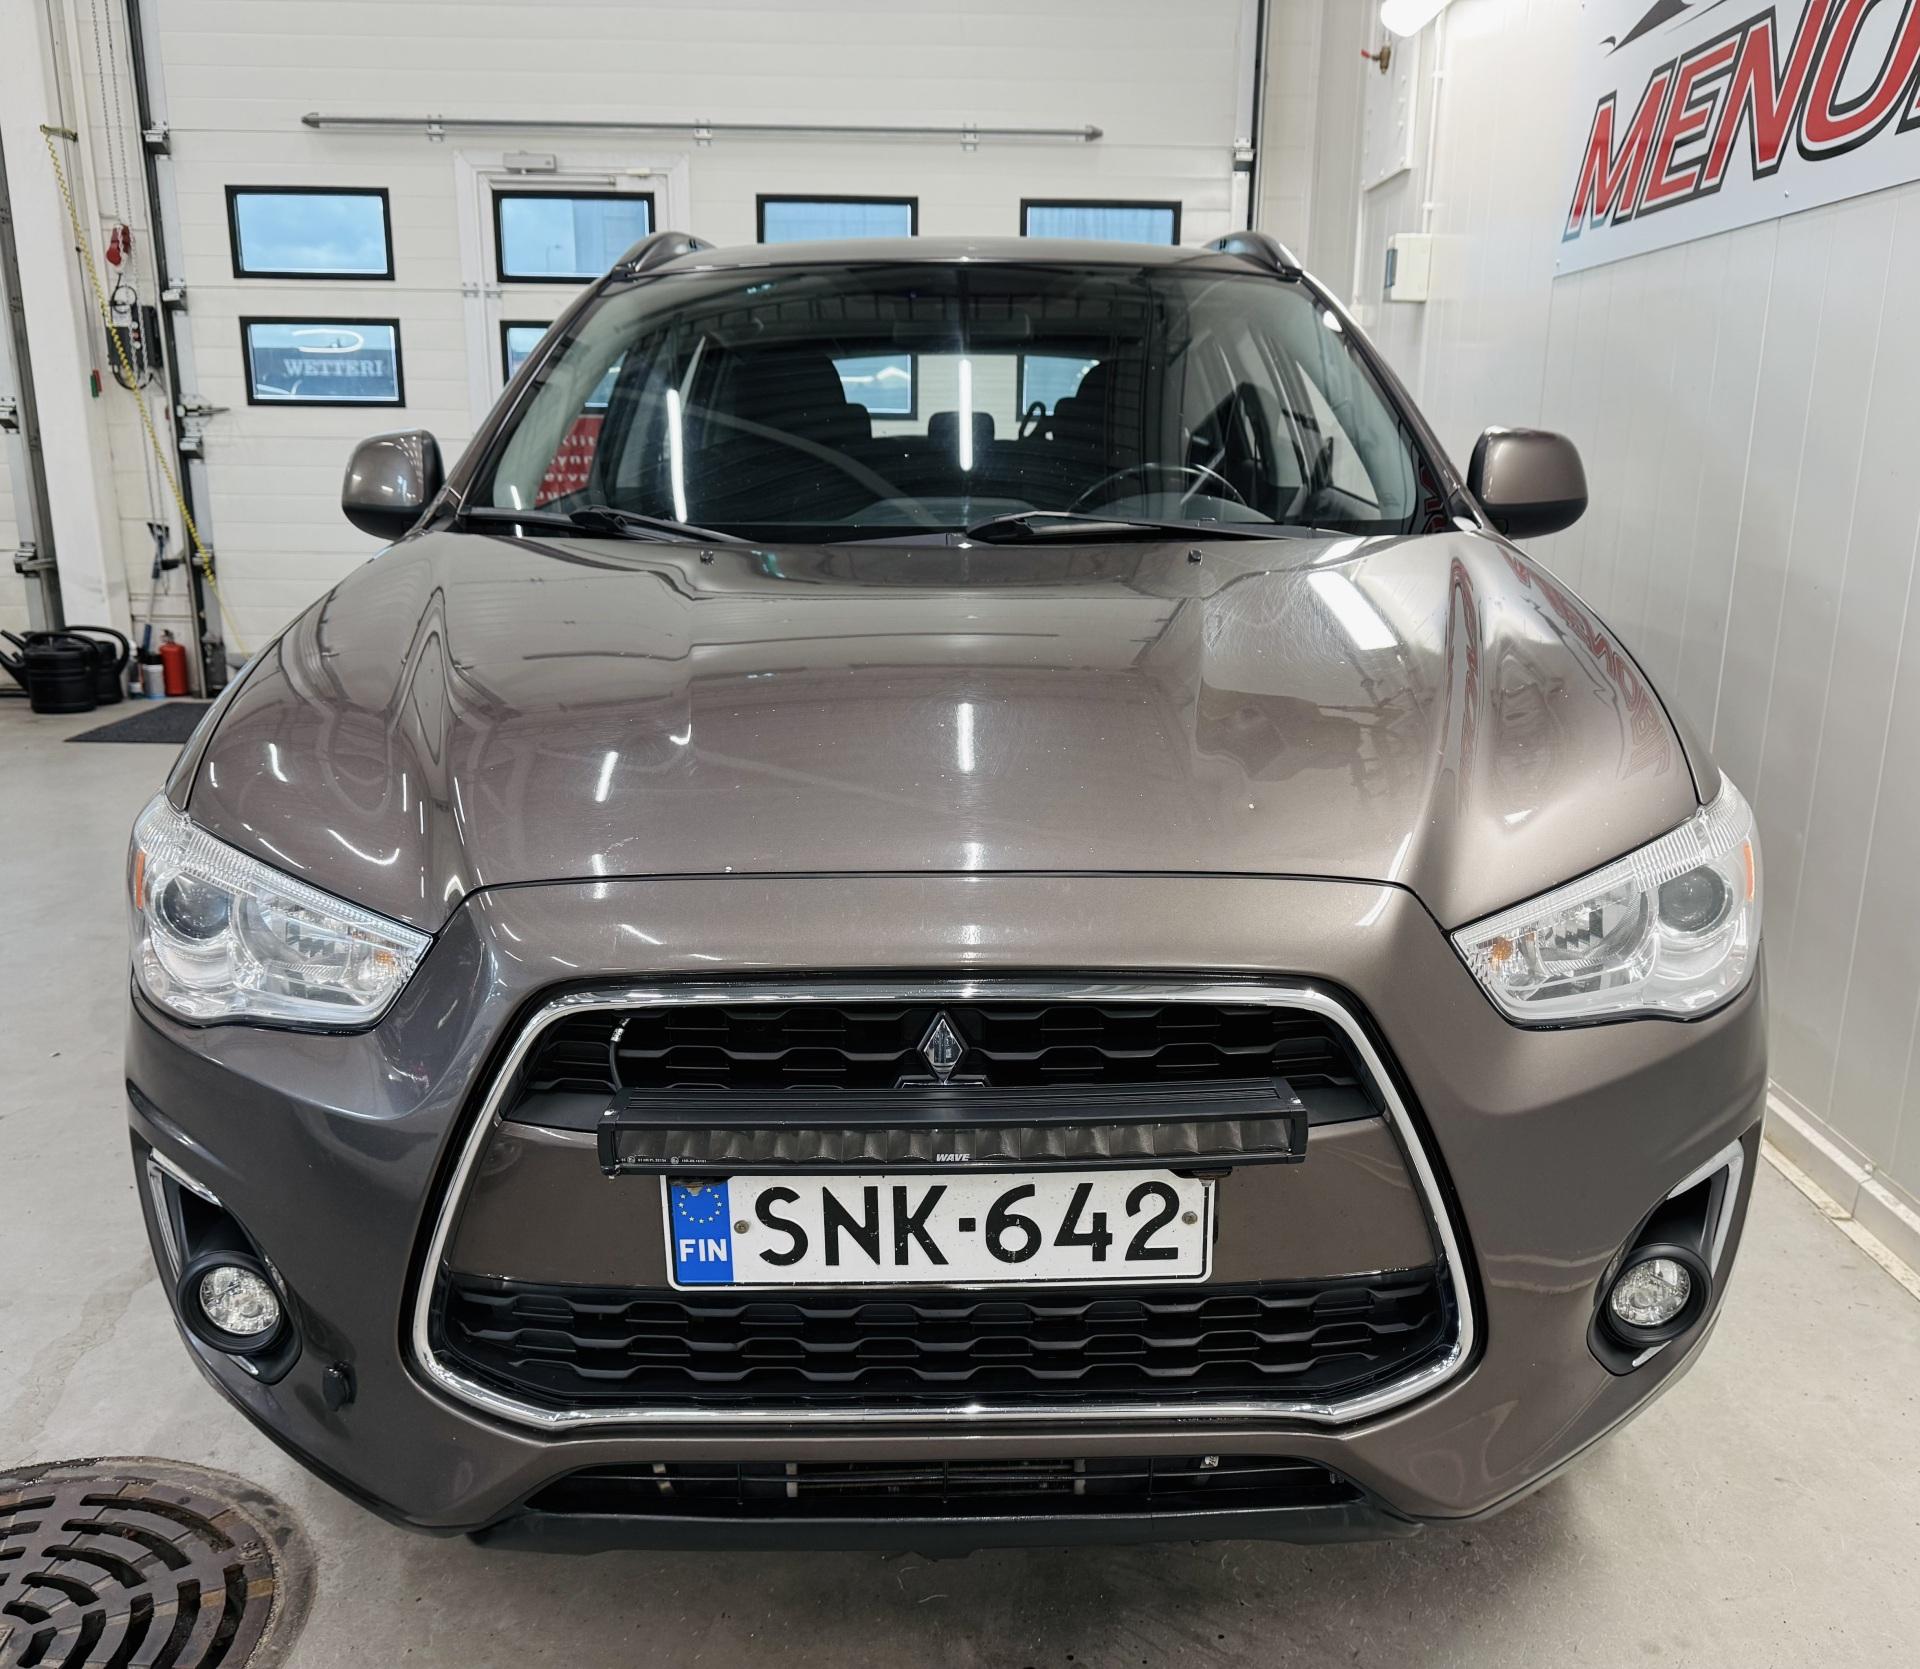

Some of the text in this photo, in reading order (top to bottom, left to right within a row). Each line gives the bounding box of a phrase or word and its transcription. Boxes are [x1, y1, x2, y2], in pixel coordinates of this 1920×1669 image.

[1561, 0, 1920, 243] MENO
[283, 359, 384, 377] WETTERI
[936, 1153, 970, 1162] WAVE
[755, 1181, 1180, 1266] SNK-642
[679, 1239, 727, 1262] FIN
